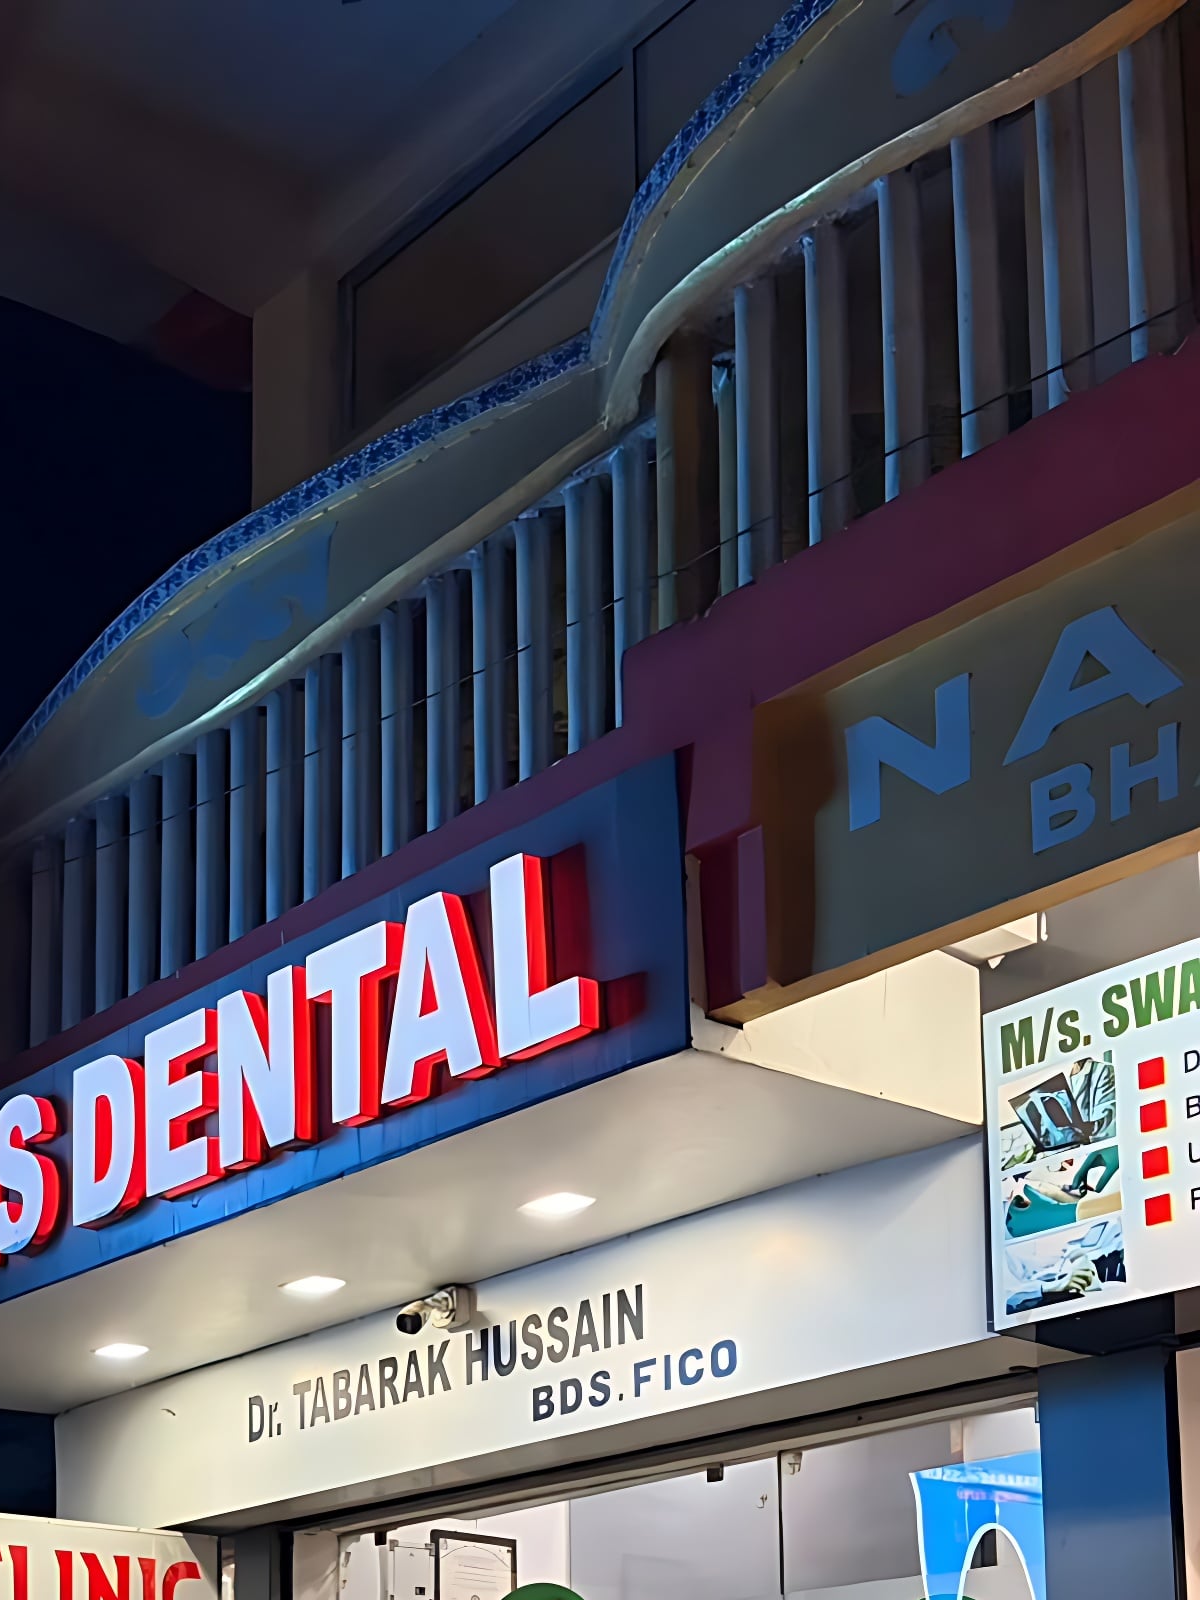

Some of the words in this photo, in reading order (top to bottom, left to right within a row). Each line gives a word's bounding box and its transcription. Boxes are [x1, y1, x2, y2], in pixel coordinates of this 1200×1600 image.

[845, 605, 1184, 832] NA
[1030, 721, 1200, 854] BH
[72, 852, 600, 1228] DENTAL
[1000, 1007, 1092, 1074] M/s.
[248, 1394, 282, 1443] Dr.
[293, 1339, 453, 1431] TABARAK
[465, 1284, 644, 1386] HUSSAIN
